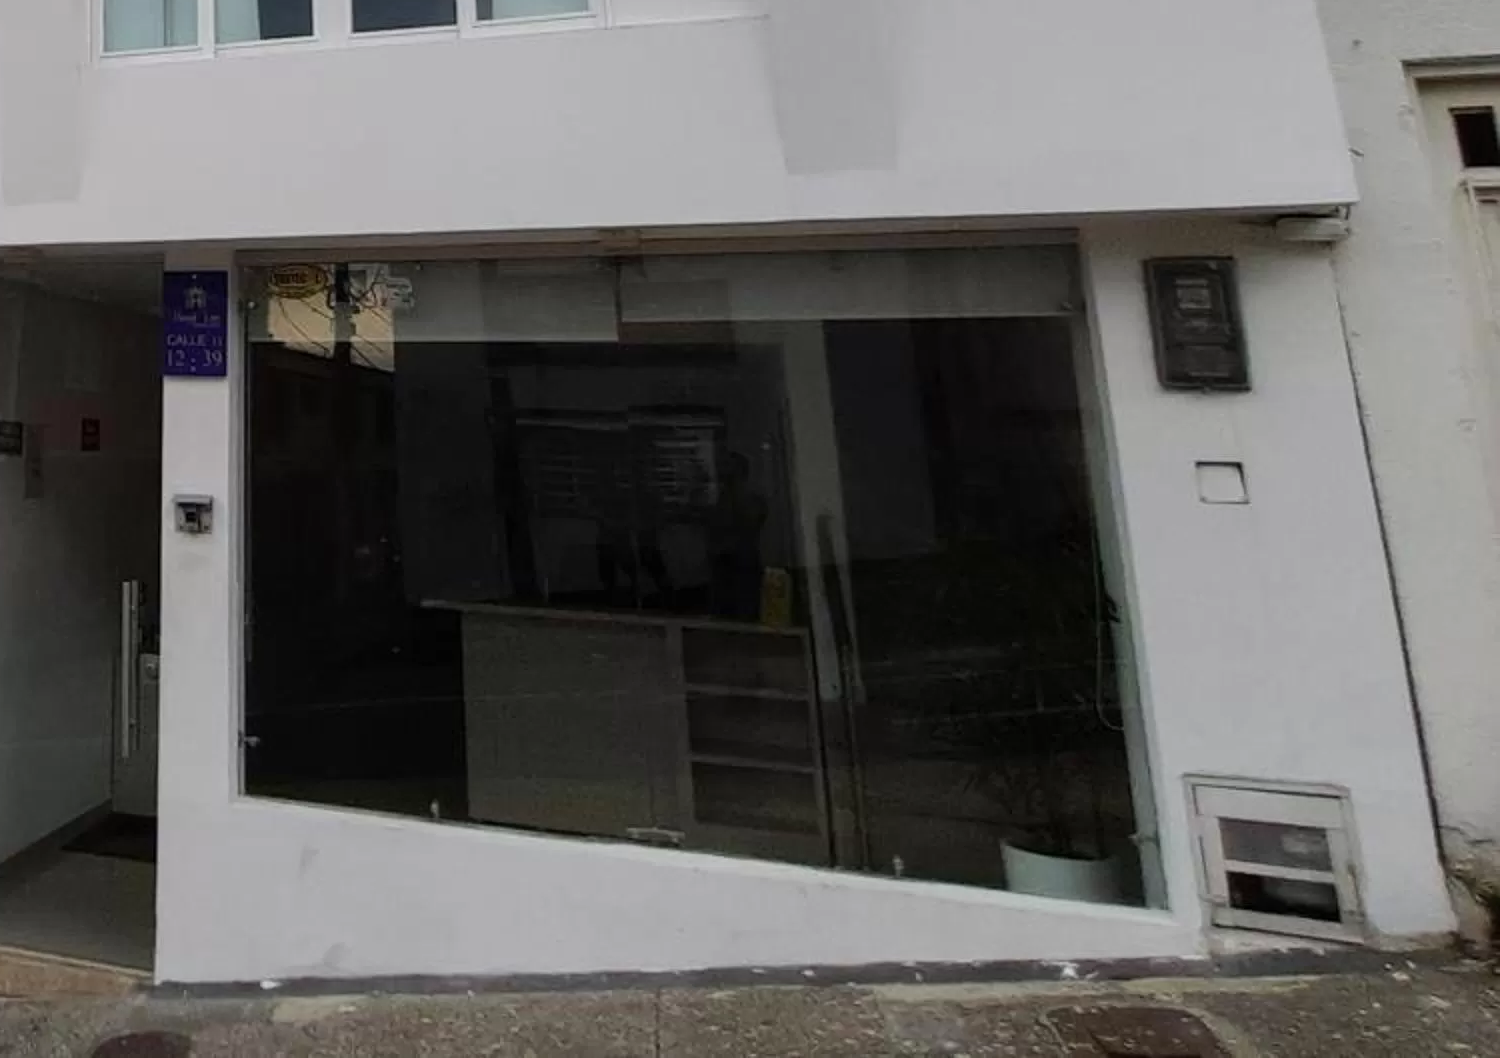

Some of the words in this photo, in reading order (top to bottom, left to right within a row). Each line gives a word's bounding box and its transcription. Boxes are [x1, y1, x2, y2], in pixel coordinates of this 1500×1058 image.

[167, 333, 207, 347] CALLE
[167, 349, 186, 367] 12
[202, 349, 223, 367] 39
